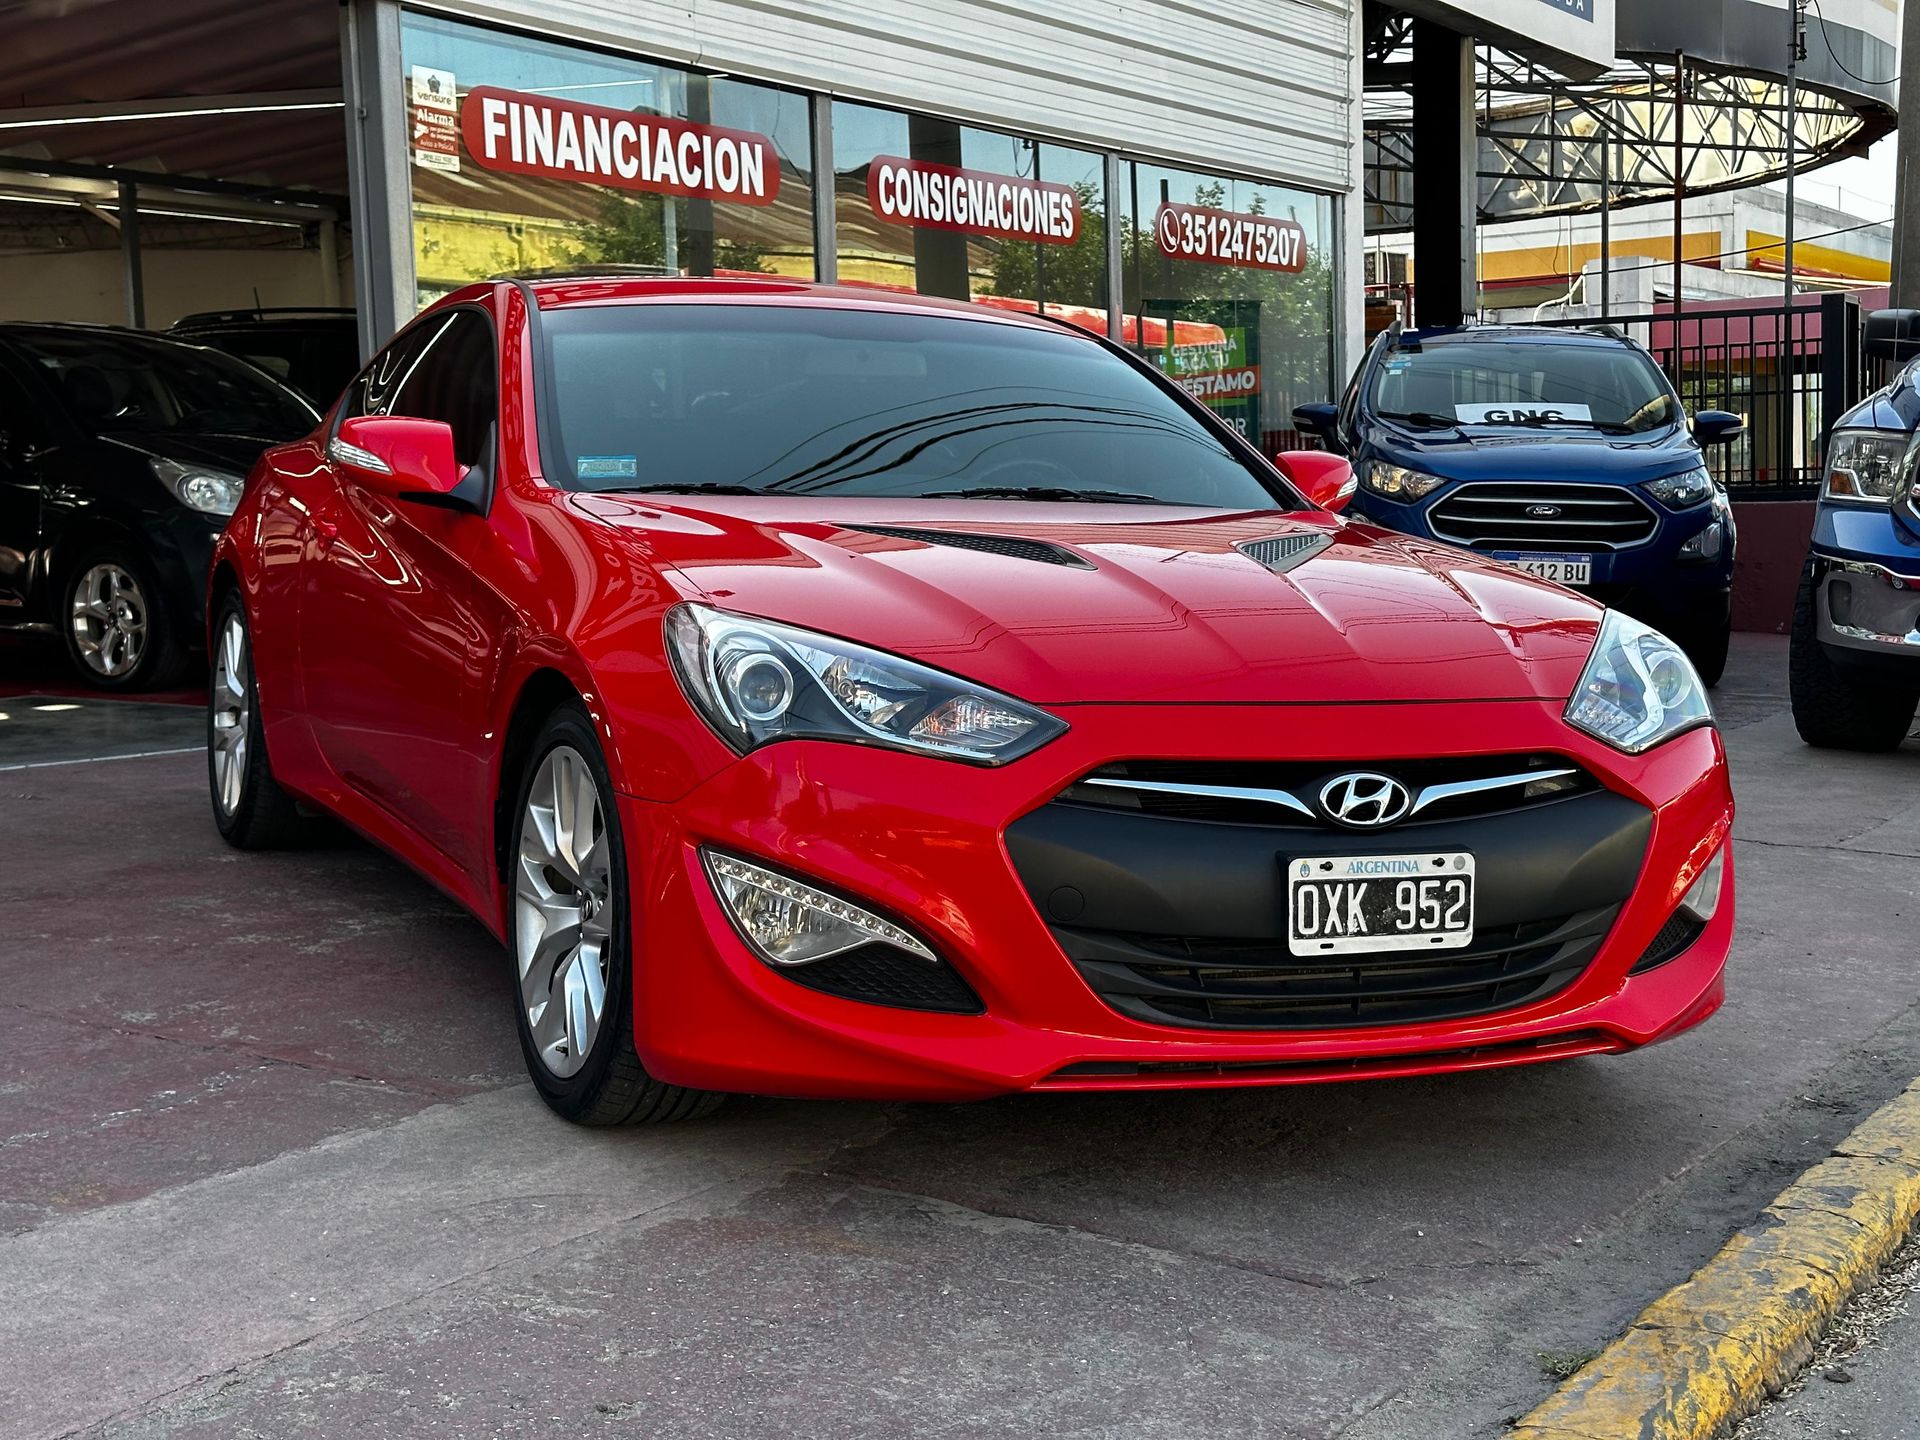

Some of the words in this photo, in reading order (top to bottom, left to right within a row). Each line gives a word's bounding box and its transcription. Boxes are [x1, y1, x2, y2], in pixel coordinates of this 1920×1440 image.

[417, 108, 454, 126] Alarma
[482, 97, 765, 197] FINANCIACION
[878, 164, 1075, 240] CONSIGNACIONES
[1180, 211, 1301, 267] 3512475207
[1212, 353, 1230, 367] TU
[1484, 409, 1564, 425] GNC
[1533, 505, 1554, 517] Ford
[1563, 563, 1586, 582] BU
[1346, 860, 1420, 875] ARGENTINA
[1297, 882, 1369, 936] OXK
[1395, 879, 1466, 930] 952
